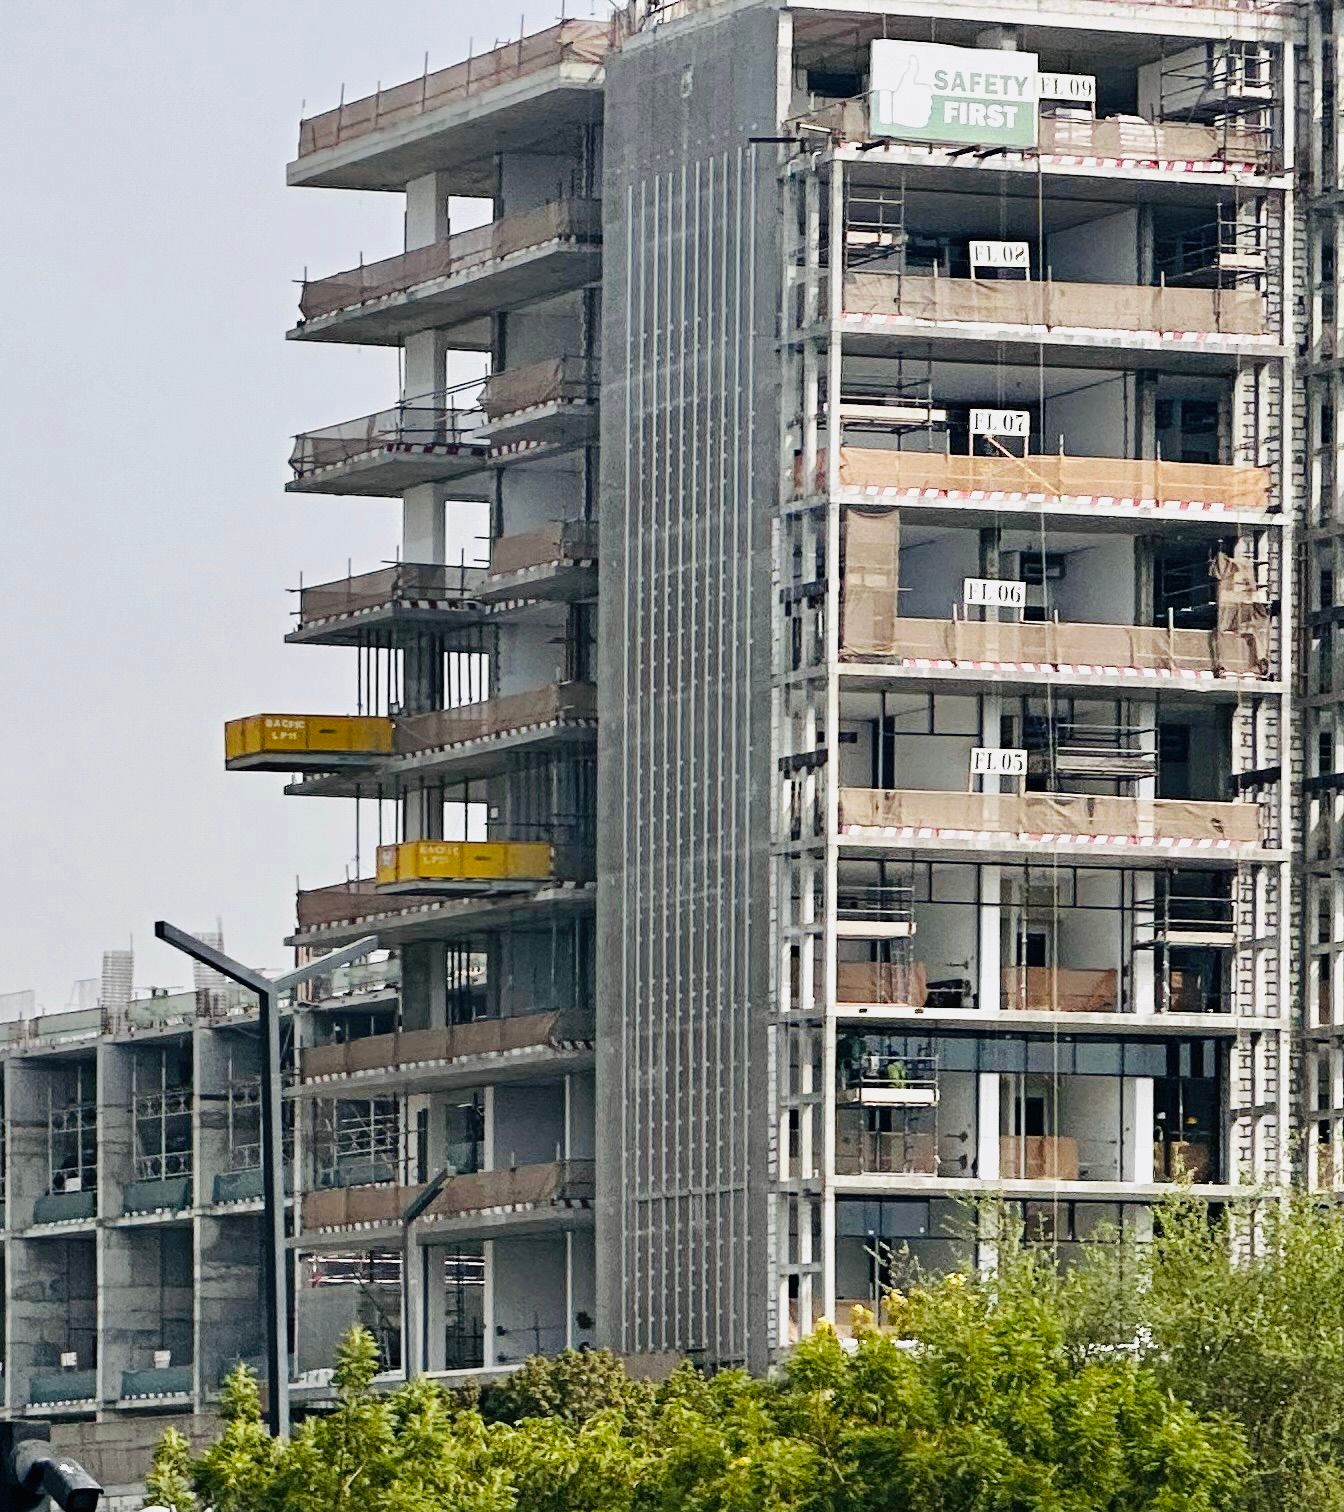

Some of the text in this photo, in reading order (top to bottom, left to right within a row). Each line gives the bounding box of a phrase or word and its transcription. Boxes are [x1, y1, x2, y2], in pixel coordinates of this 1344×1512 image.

[934, 70, 1028, 97] SAFETY
[1041, 77, 1092, 98] FL 09
[943, 101, 1019, 128] FIRST
[975, 245, 997, 263] FL
[974, 413, 1024, 432] FL 07
[968, 583, 1022, 603] FL 06
[975, 753, 1023, 771] FL 05
